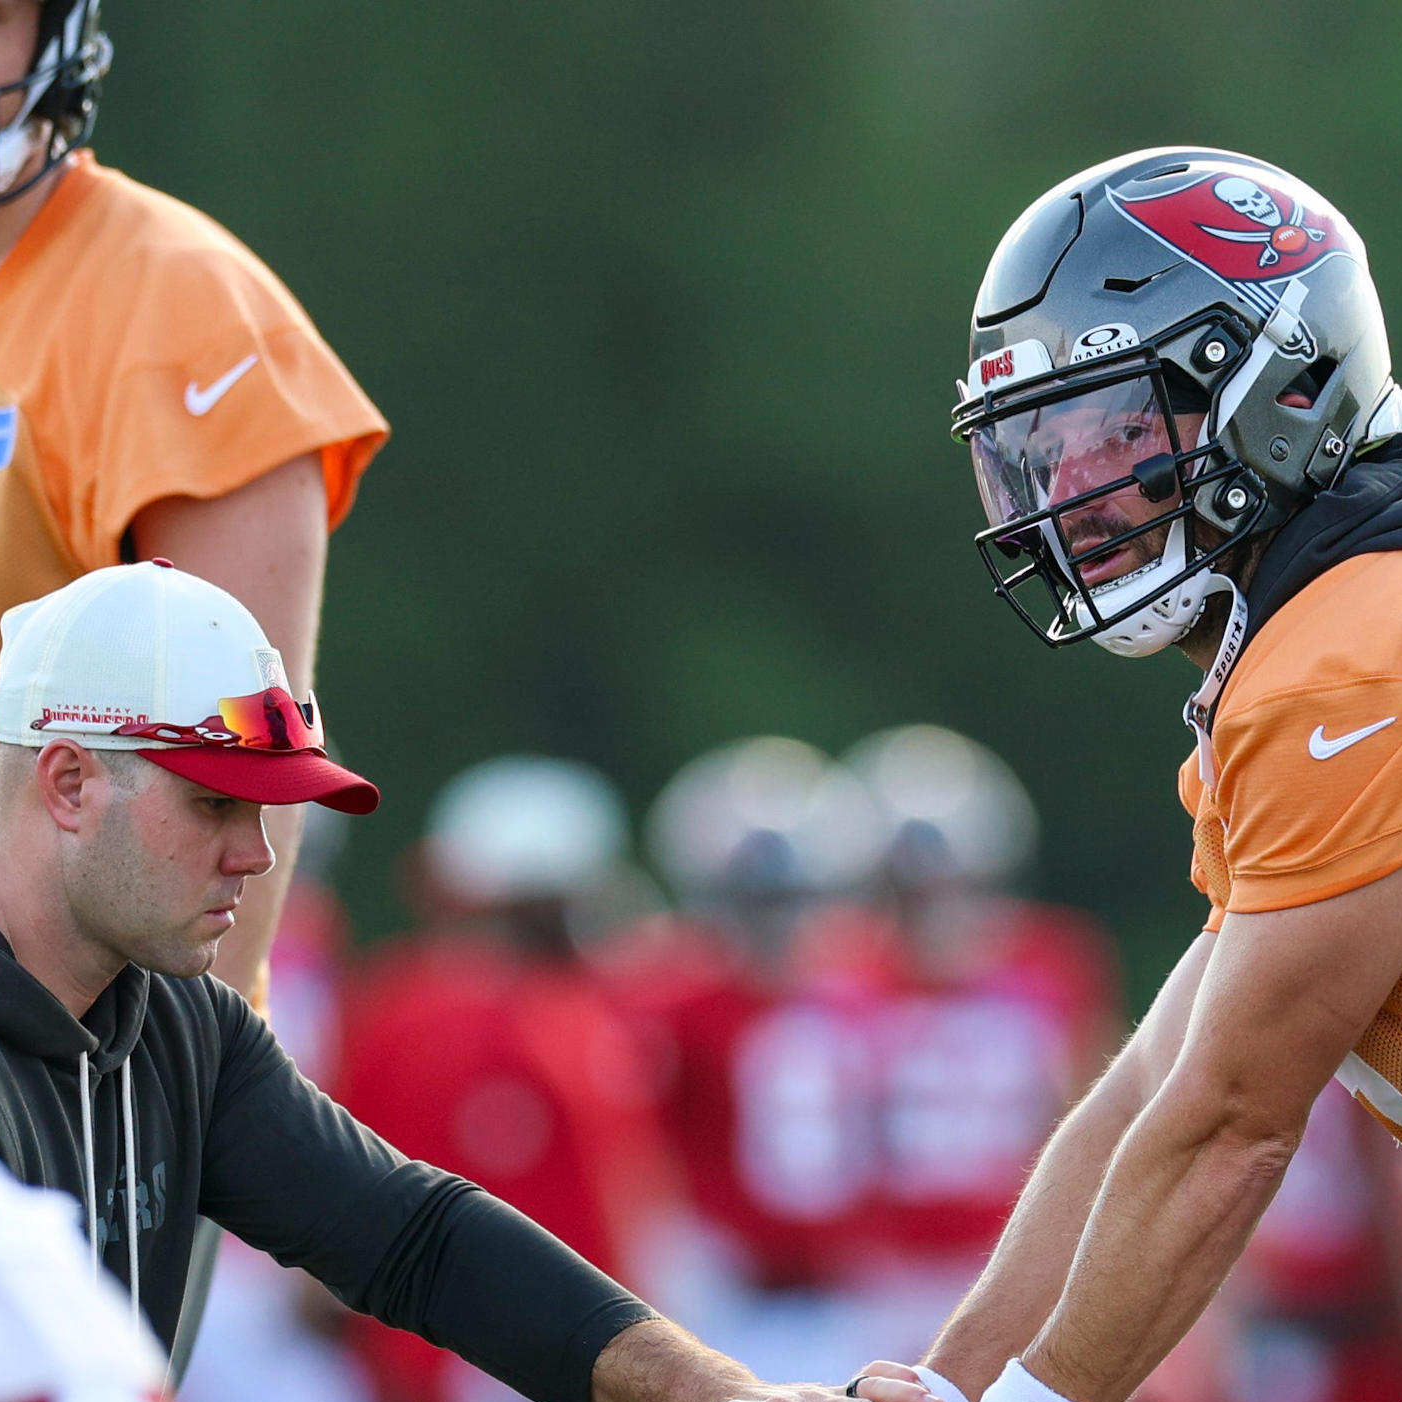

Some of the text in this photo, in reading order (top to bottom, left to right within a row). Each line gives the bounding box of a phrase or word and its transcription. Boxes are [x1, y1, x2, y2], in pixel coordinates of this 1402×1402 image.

[1074, 337, 1135, 362] OAKLEY
[980, 349, 1015, 386] BUCS
[1214, 631, 1241, 683] SPORT
[57, 704, 97, 712] TAMPA
